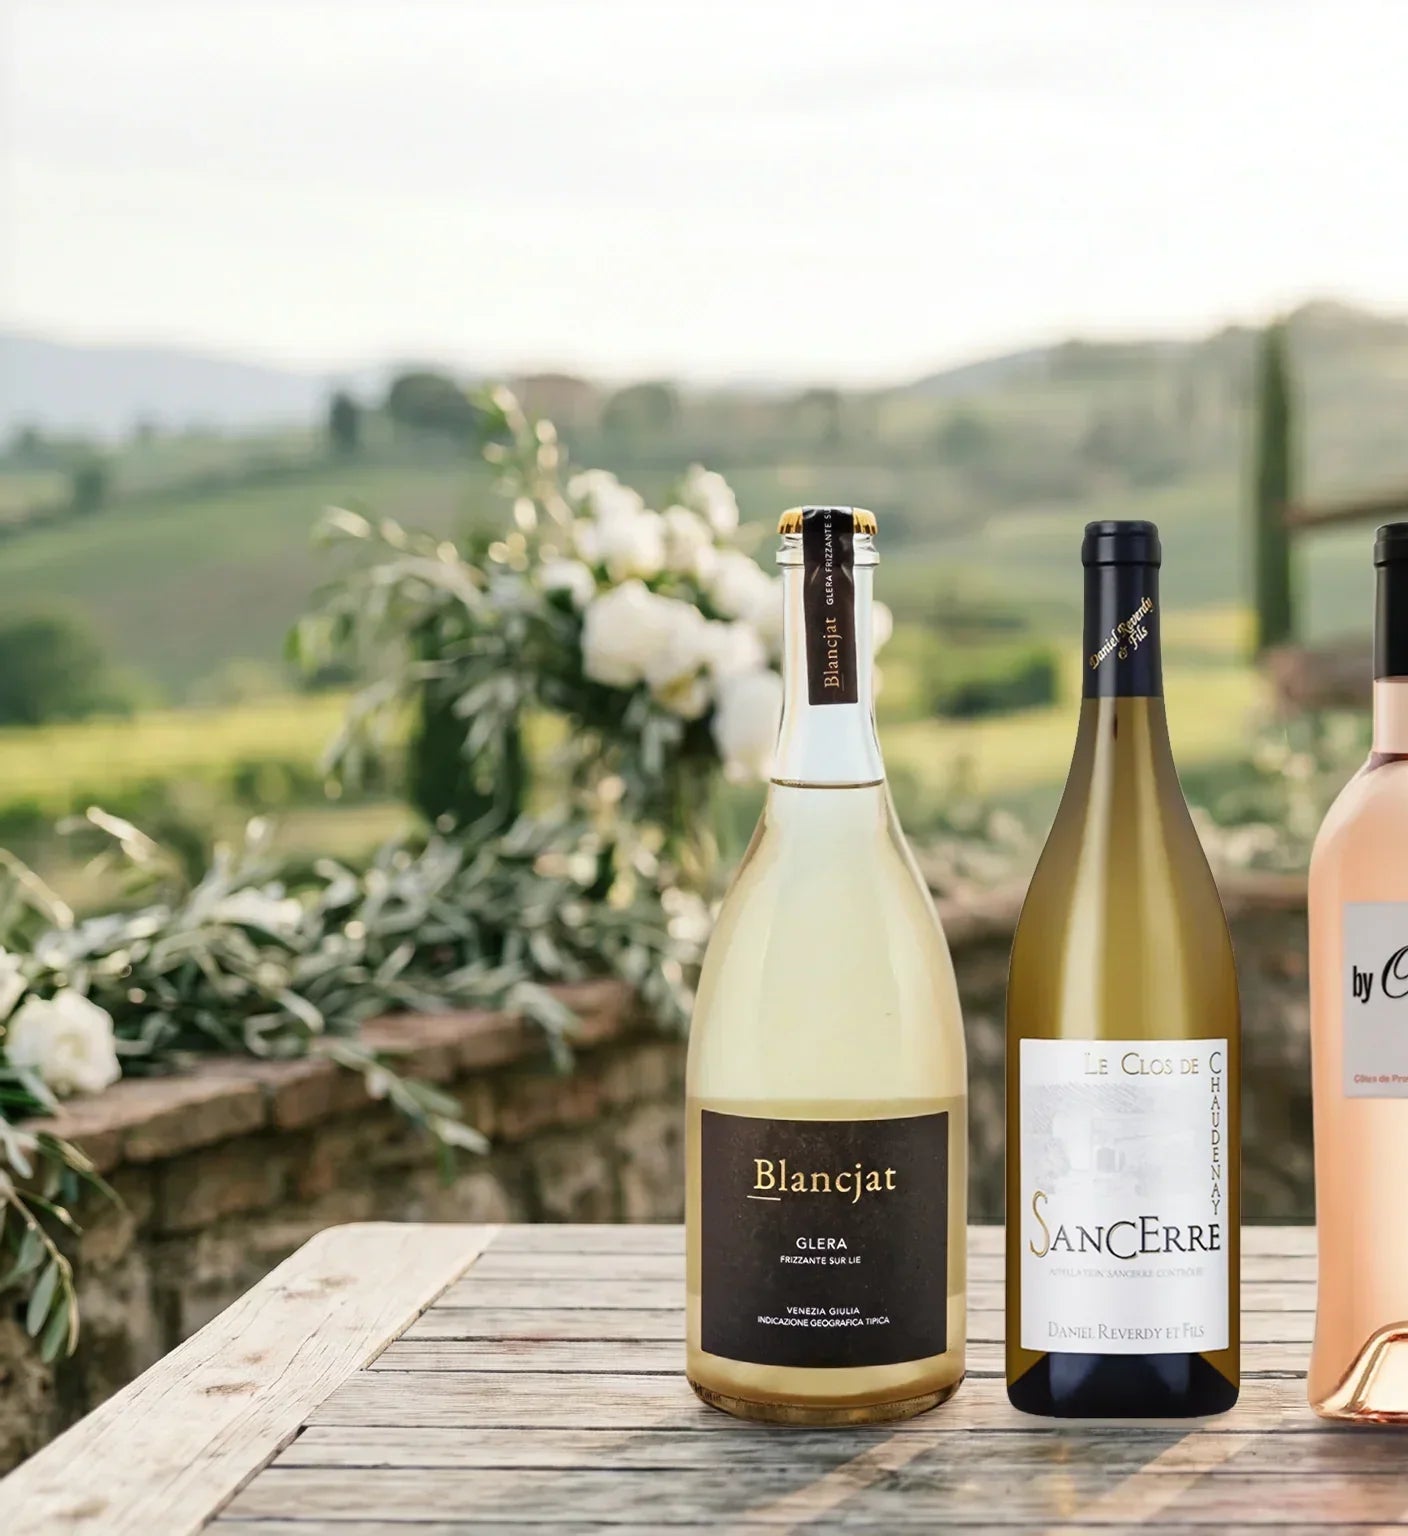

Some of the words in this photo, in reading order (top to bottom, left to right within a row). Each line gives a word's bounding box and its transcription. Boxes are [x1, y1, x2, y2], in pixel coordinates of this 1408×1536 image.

[824, 522, 833, 573] FRIZZANTE
[825, 574, 834, 606] GLERA
[823, 617, 843, 688] Blancjat
[1088, 628, 1120, 670] Daniel
[1128, 624, 1149, 651] Fils
[1352, 964, 1374, 1004] by
[1121, 1051, 1173, 1076] CLOS
[1180, 1058, 1199, 1075] DE
[1208, 1050, 1222, 1216] CHAUDENAY
[753, 1157, 897, 1204] Blancjat
[1029, 1189, 1221, 1259] SANCERRE
[795, 1236, 848, 1250] GLERA
[779, 1255, 827, 1265] FRIZZANTE
[829, 1256, 847, 1265] SUR
[848, 1255, 862, 1265] LIE
[757, 1315, 809, 1327] INDICAZIONE
[809, 1318, 864, 1328] GEOGRAFICA
[865, 1316, 891, 1325] TIPICA
[786, 1306, 827, 1316] VENEZIA
[828, 1306, 861, 1316] GIULIA
[1098, 1323, 1163, 1341] REVERDY
[1166, 1327, 1180, 1340] ET
